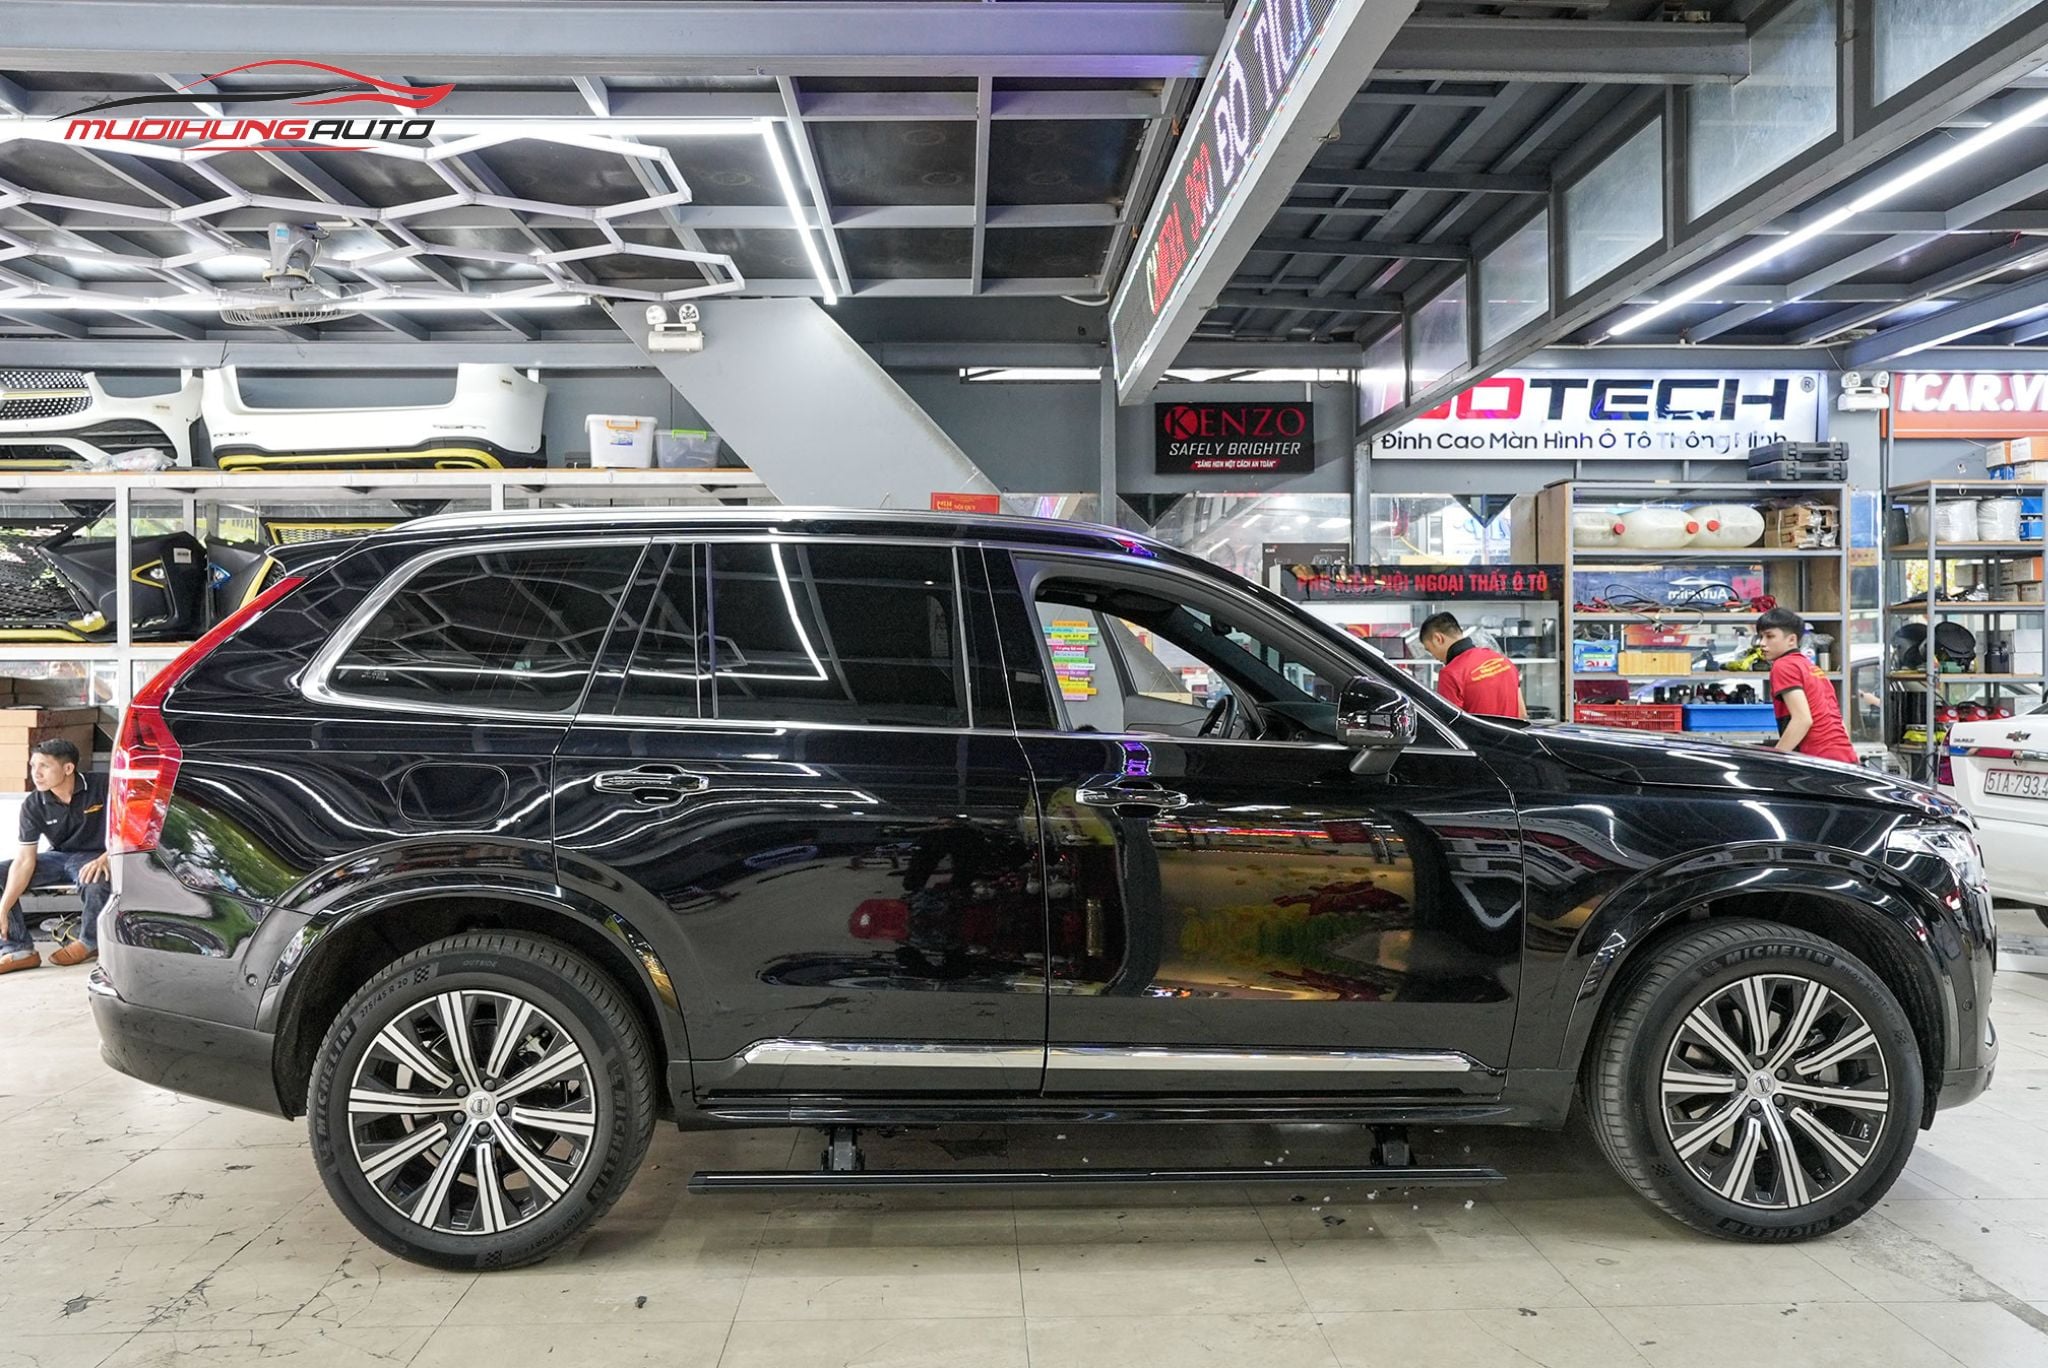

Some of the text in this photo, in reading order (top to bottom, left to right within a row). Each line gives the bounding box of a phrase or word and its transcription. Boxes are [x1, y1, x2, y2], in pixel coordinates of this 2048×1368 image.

[1900, 373, 2048, 412] ICAR.V
[1164, 405, 1307, 440] KENZO
[1169, 442, 1301, 456] SAFELY BRIGHTER
[1381, 431, 1432, 450] Đỉnh
[1436, 432, 1485, 450] Cao
[1489, 431, 1538, 450] Màn
[1544, 431, 1593, 450] Hình
[1599, 428, 1616, 449] Ô
[1624, 428, 1651, 449] Tô
[1381, 571, 1410, 597] NỘI
[1414, 574, 1463, 596] NGOẠI
[1468, 568, 1508, 592] THẤT
[1513, 570, 1524, 592] Ô
[1527, 570, 1549, 592] TÔ
[1725, 944, 1830, 965] MICHELIN
[316, 1024, 353, 1138] MICHELIN
